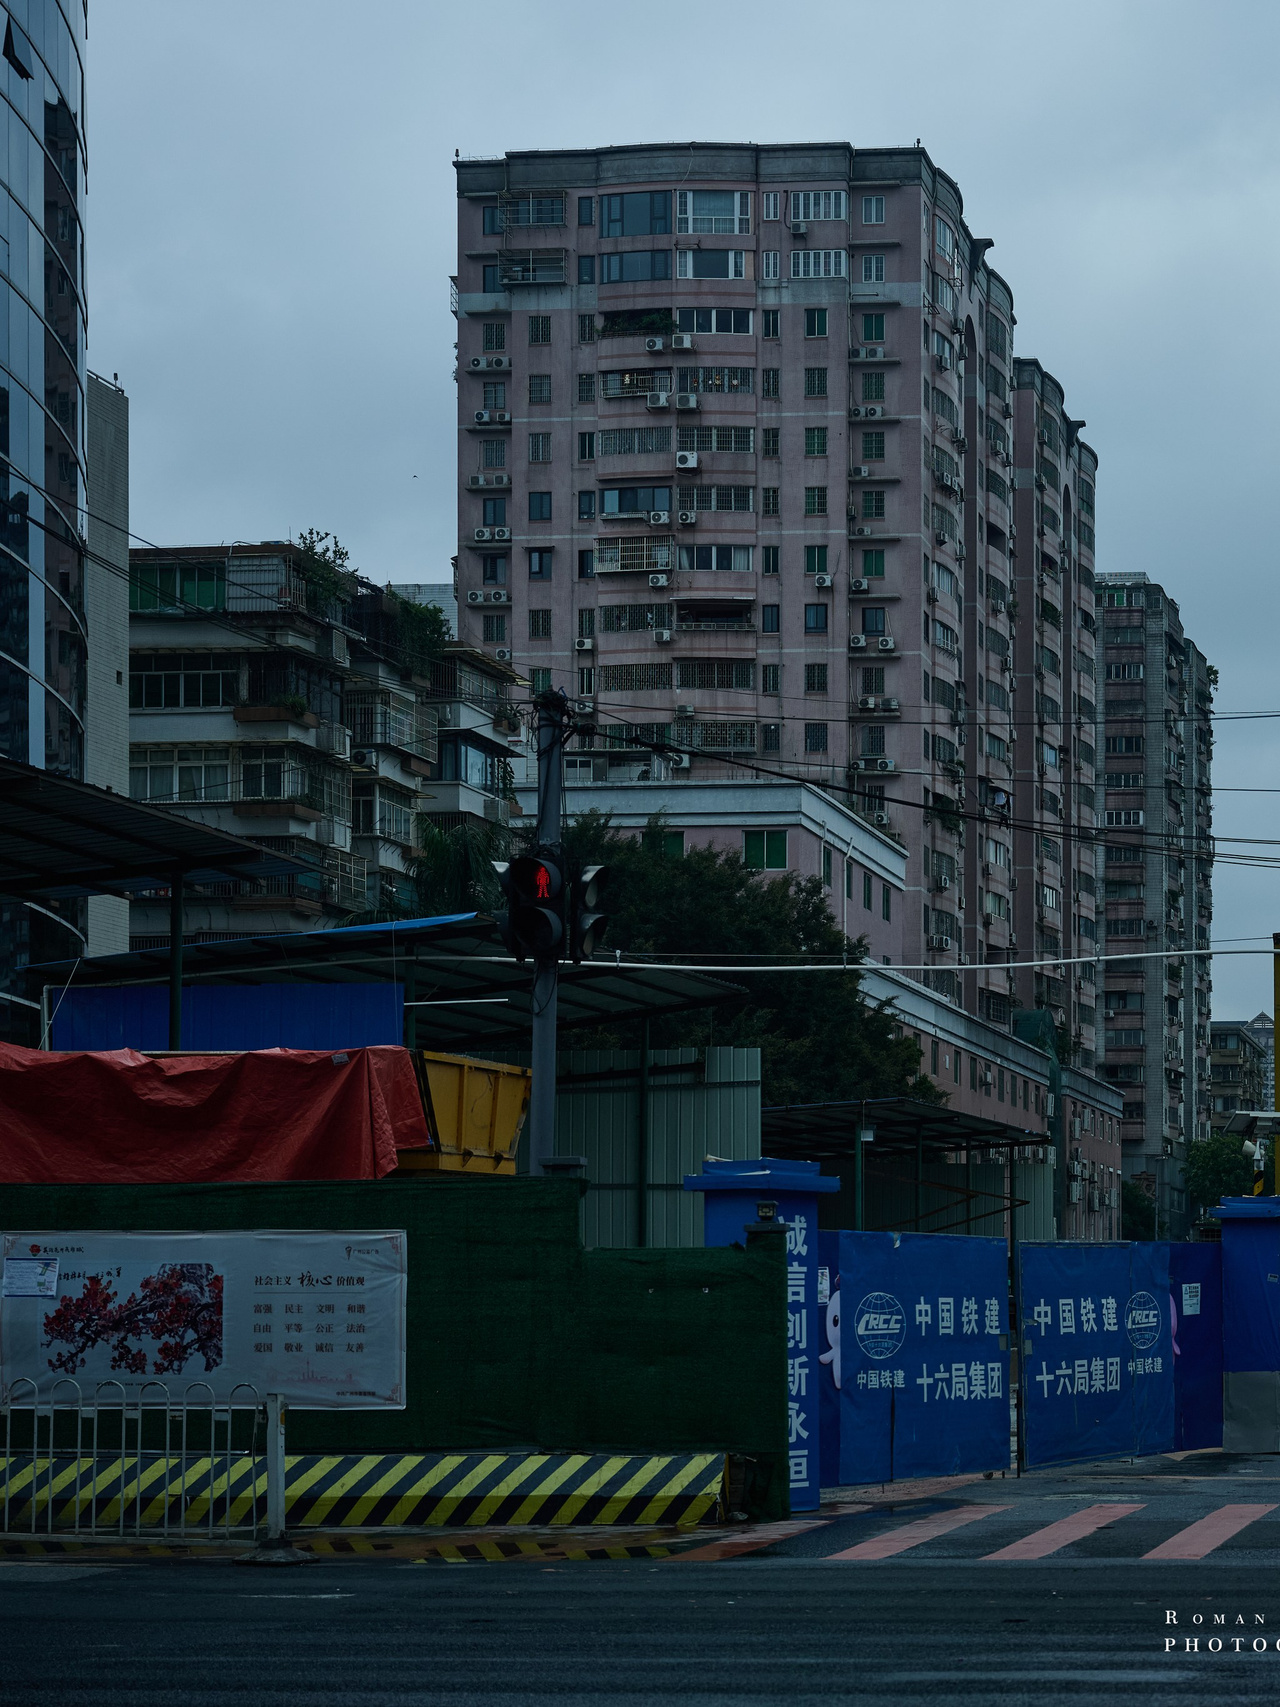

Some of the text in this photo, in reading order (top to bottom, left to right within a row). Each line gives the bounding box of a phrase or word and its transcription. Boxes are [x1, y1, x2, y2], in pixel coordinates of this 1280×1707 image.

[254, 1270, 365, 1287] 社会主义 核心 价值观
[253, 1304, 365, 1314] 富强 民主 文明 和谐
[915, 1296, 1000, 1336] 中国铁建
[1034, 1296, 1118, 1336] 中国铁建
[253, 1323, 365, 1333] 自由 平等 公正 法治
[857, 1314, 902, 1335] CRCC
[254, 1342, 364, 1353] 爱国 敬业 诚信 友善
[1128, 1357, 1163, 1375] 中国铁建
[857, 1369, 905, 1390] 中国铁建
[916, 1361, 1002, 1403] 十六局集团
[1036, 1356, 1121, 1398] 十六局集团
